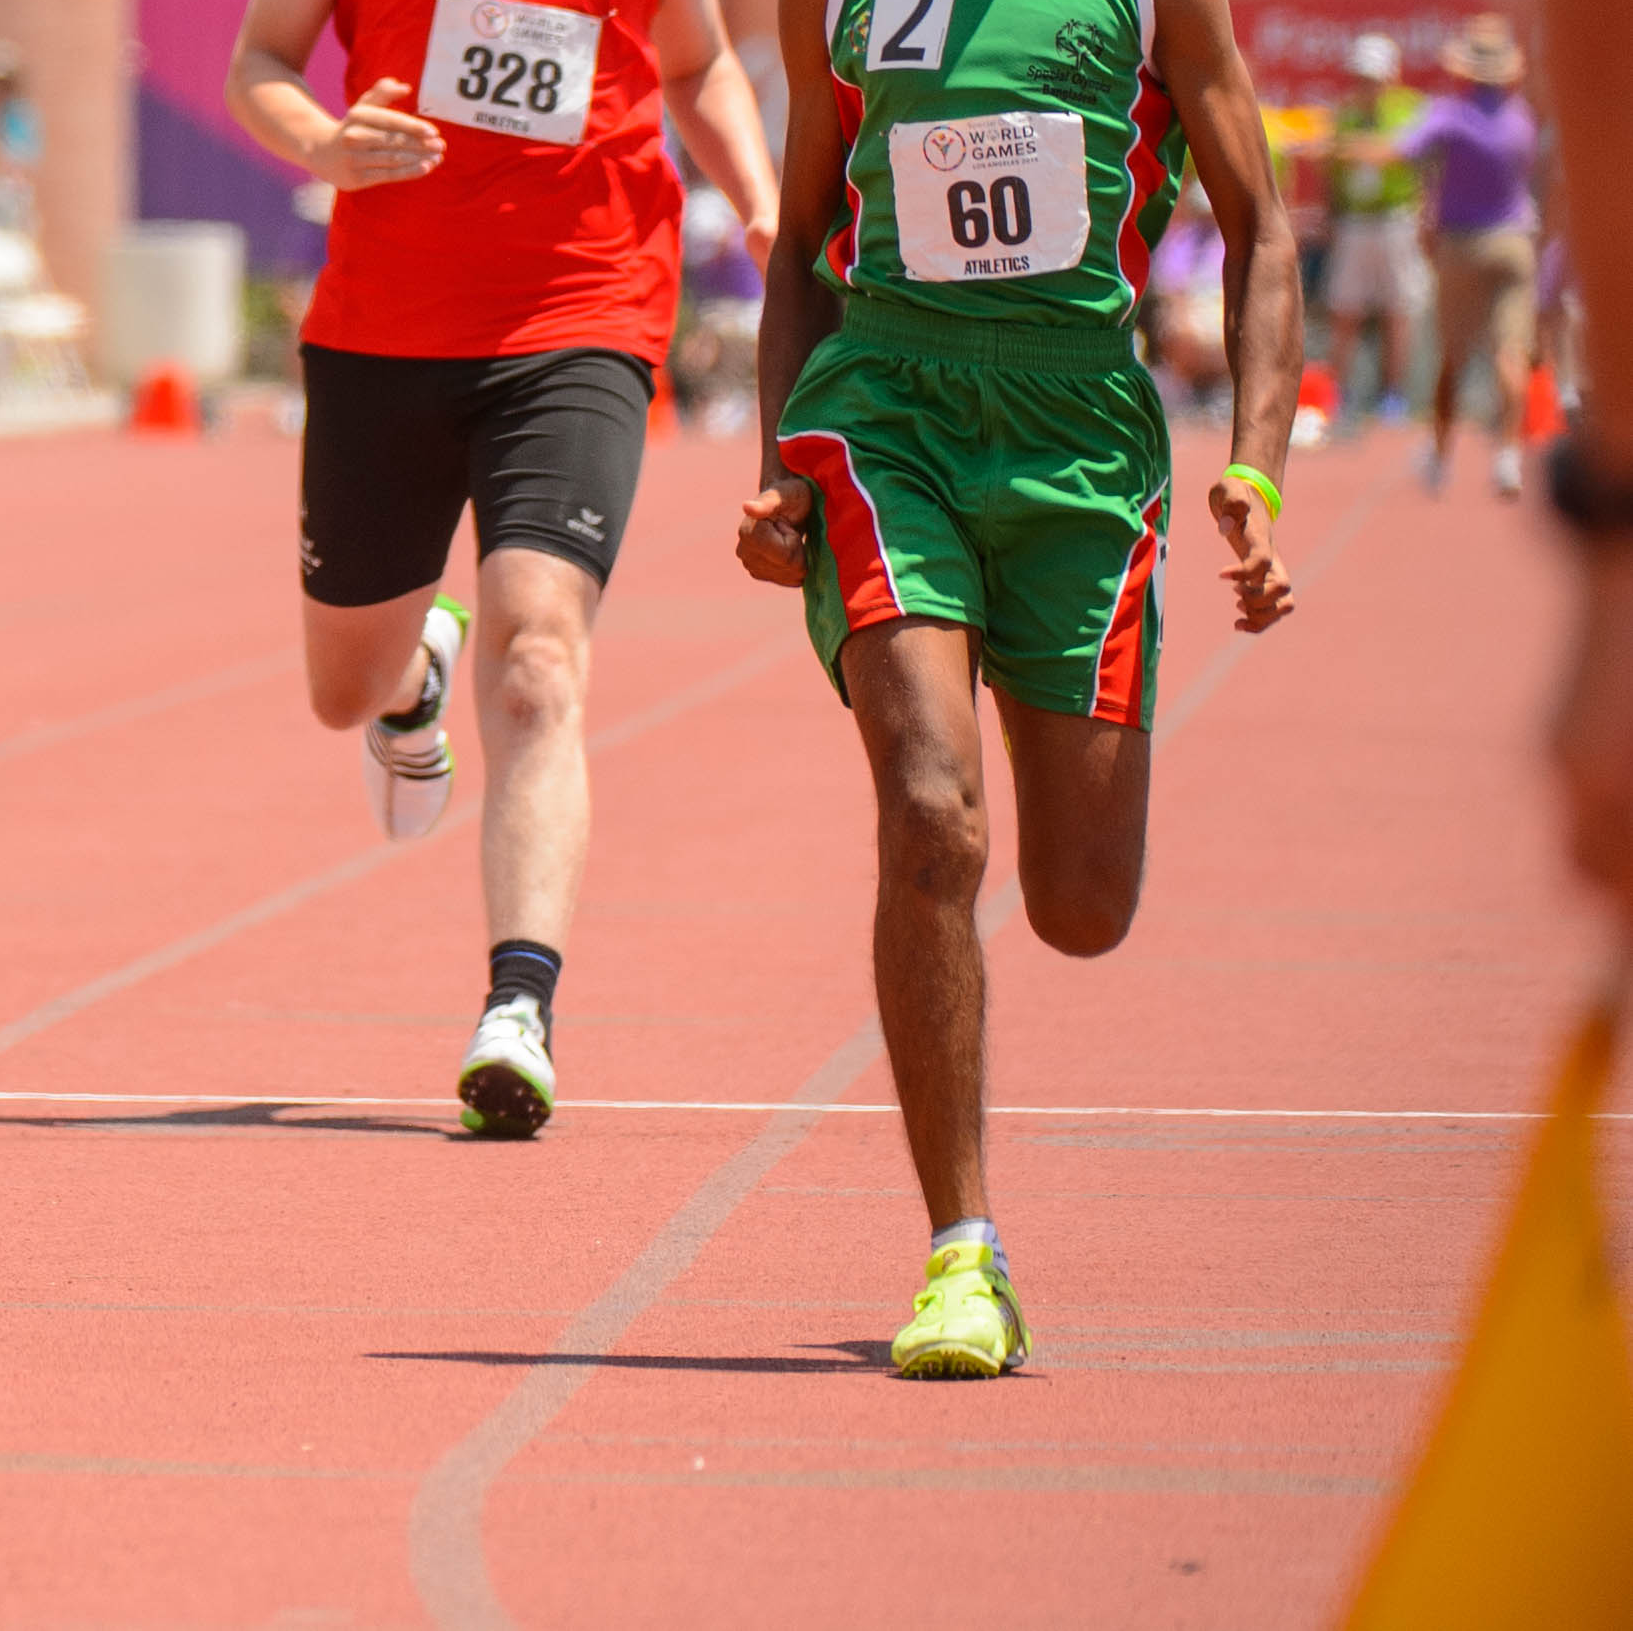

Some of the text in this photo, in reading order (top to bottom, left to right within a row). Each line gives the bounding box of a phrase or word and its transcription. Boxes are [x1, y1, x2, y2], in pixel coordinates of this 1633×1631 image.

[457, 46, 562, 114] 328
[972, 140, 1037, 161] GAMES
[946, 175, 1033, 248] 60
[963, 256, 1031, 275] ATHLETICS
